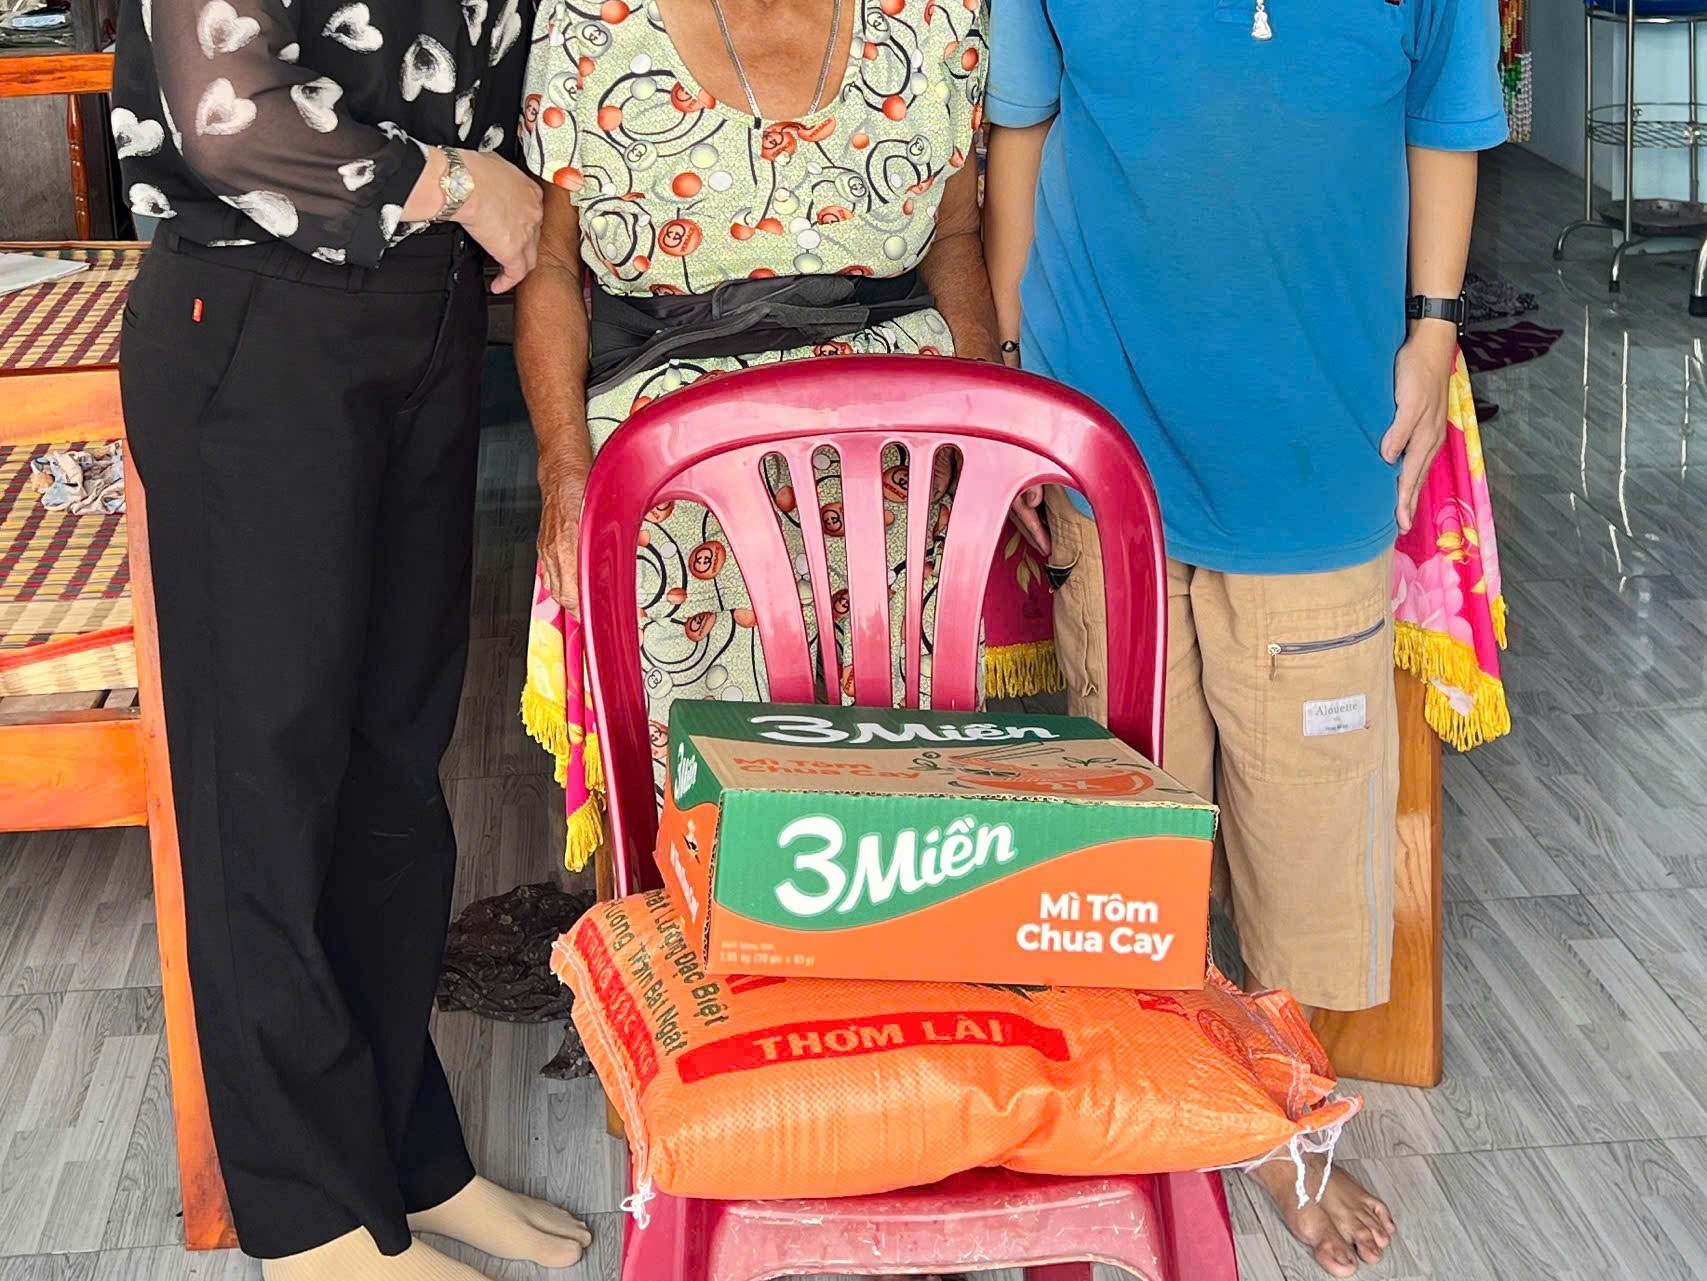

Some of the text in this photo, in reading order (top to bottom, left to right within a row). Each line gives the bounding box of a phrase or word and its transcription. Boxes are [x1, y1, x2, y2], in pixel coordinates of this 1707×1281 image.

[1040, 892, 1158, 924] Mì Tôm
[1016, 924, 1174, 961] Chua Cay
[753, 1015, 1004, 1061] THƠM LÀI
